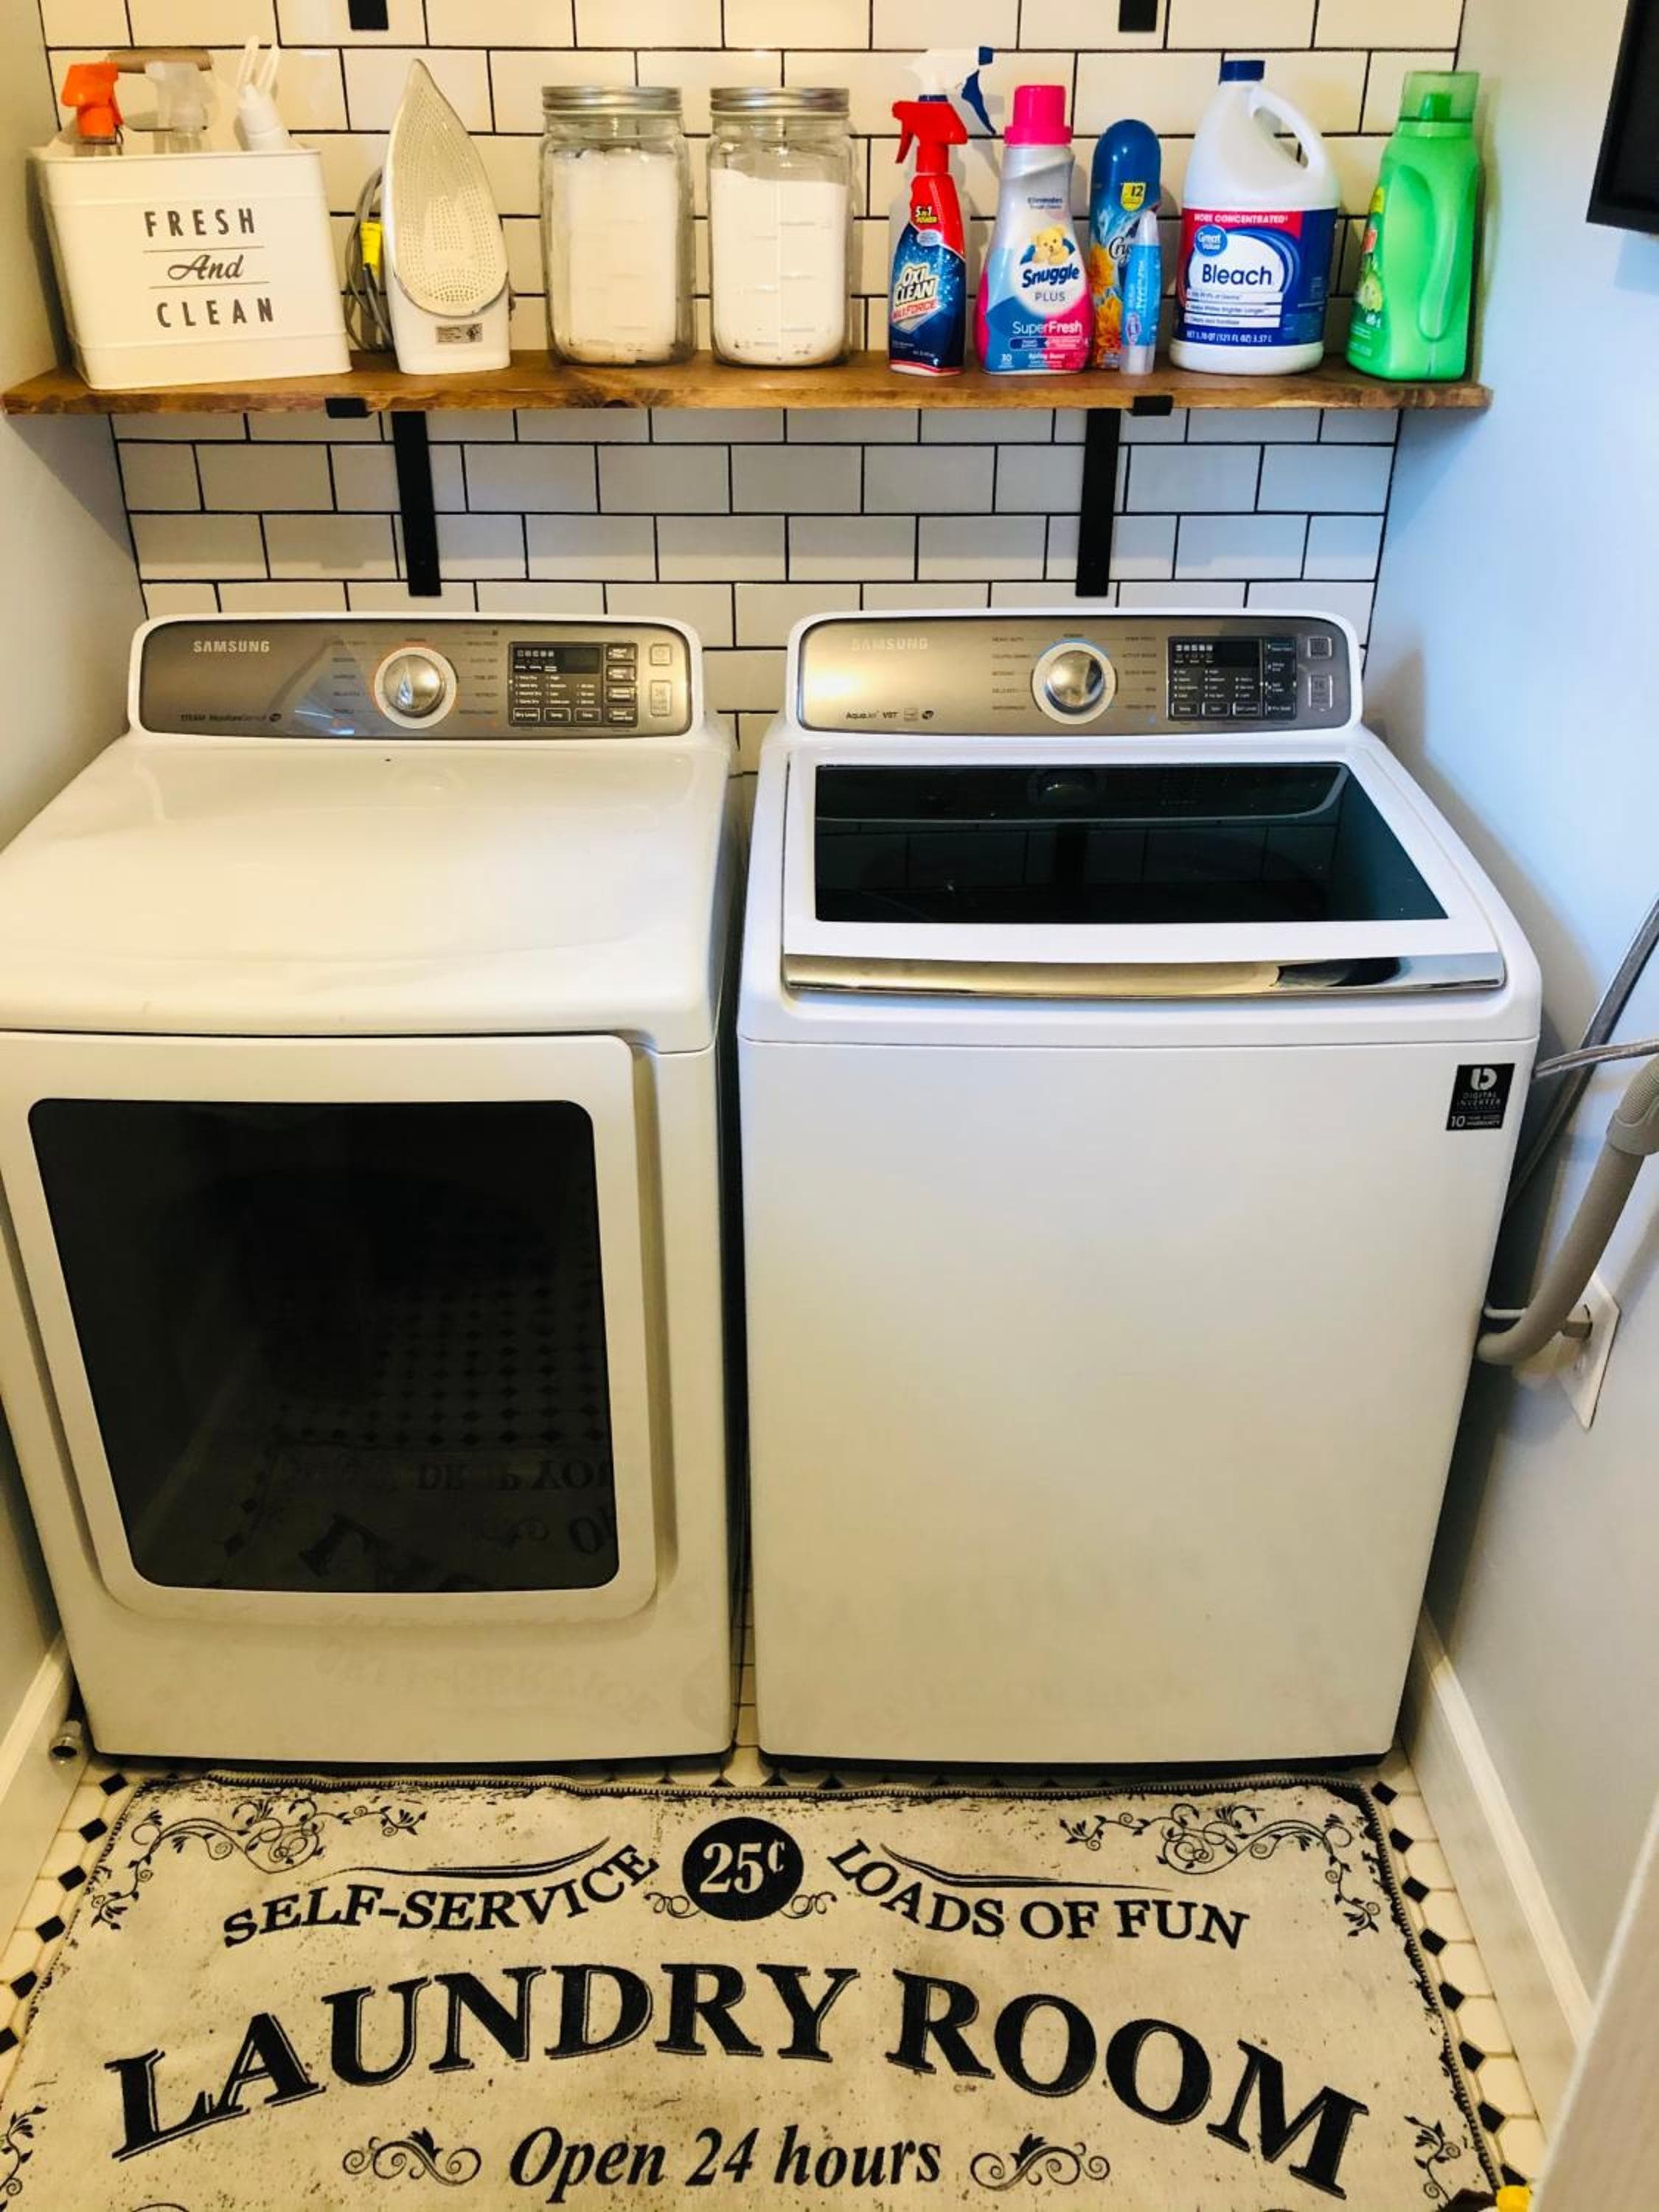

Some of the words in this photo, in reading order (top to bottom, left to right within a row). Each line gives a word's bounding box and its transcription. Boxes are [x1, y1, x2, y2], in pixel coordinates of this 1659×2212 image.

[144, 208, 255, 237] FRESH
[167, 254, 244, 280] And
[1022, 263, 1080, 288] Snuggle
[1202, 263, 1272, 285] Bleach
[895, 279, 936, 306] CLEAN
[1034, 291, 1066, 302] PLUS
[156, 297, 274, 328] CLEAN
[1012, 321, 1082, 337] SuperFresh
[193, 641, 271, 653] SAMSUNG
[851, 637, 929, 650] SAMSUNG
[1450, 1116, 1465, 1127] 10
[223, 1839, 659, 1947] SELF-SERVICE
[827, 1838, 1005, 1938] LOADS
[1020, 1900, 1102, 1940] OF
[1114, 1899, 1251, 1949] FUN
[103, 1963, 861, 2160] LAUNDRY
[886, 1968, 1371, 2201] ROOM
[509, 2126, 666, 2204] Open
[686, 2125, 760, 2187] 24
[774, 2124, 942, 2188] hours
